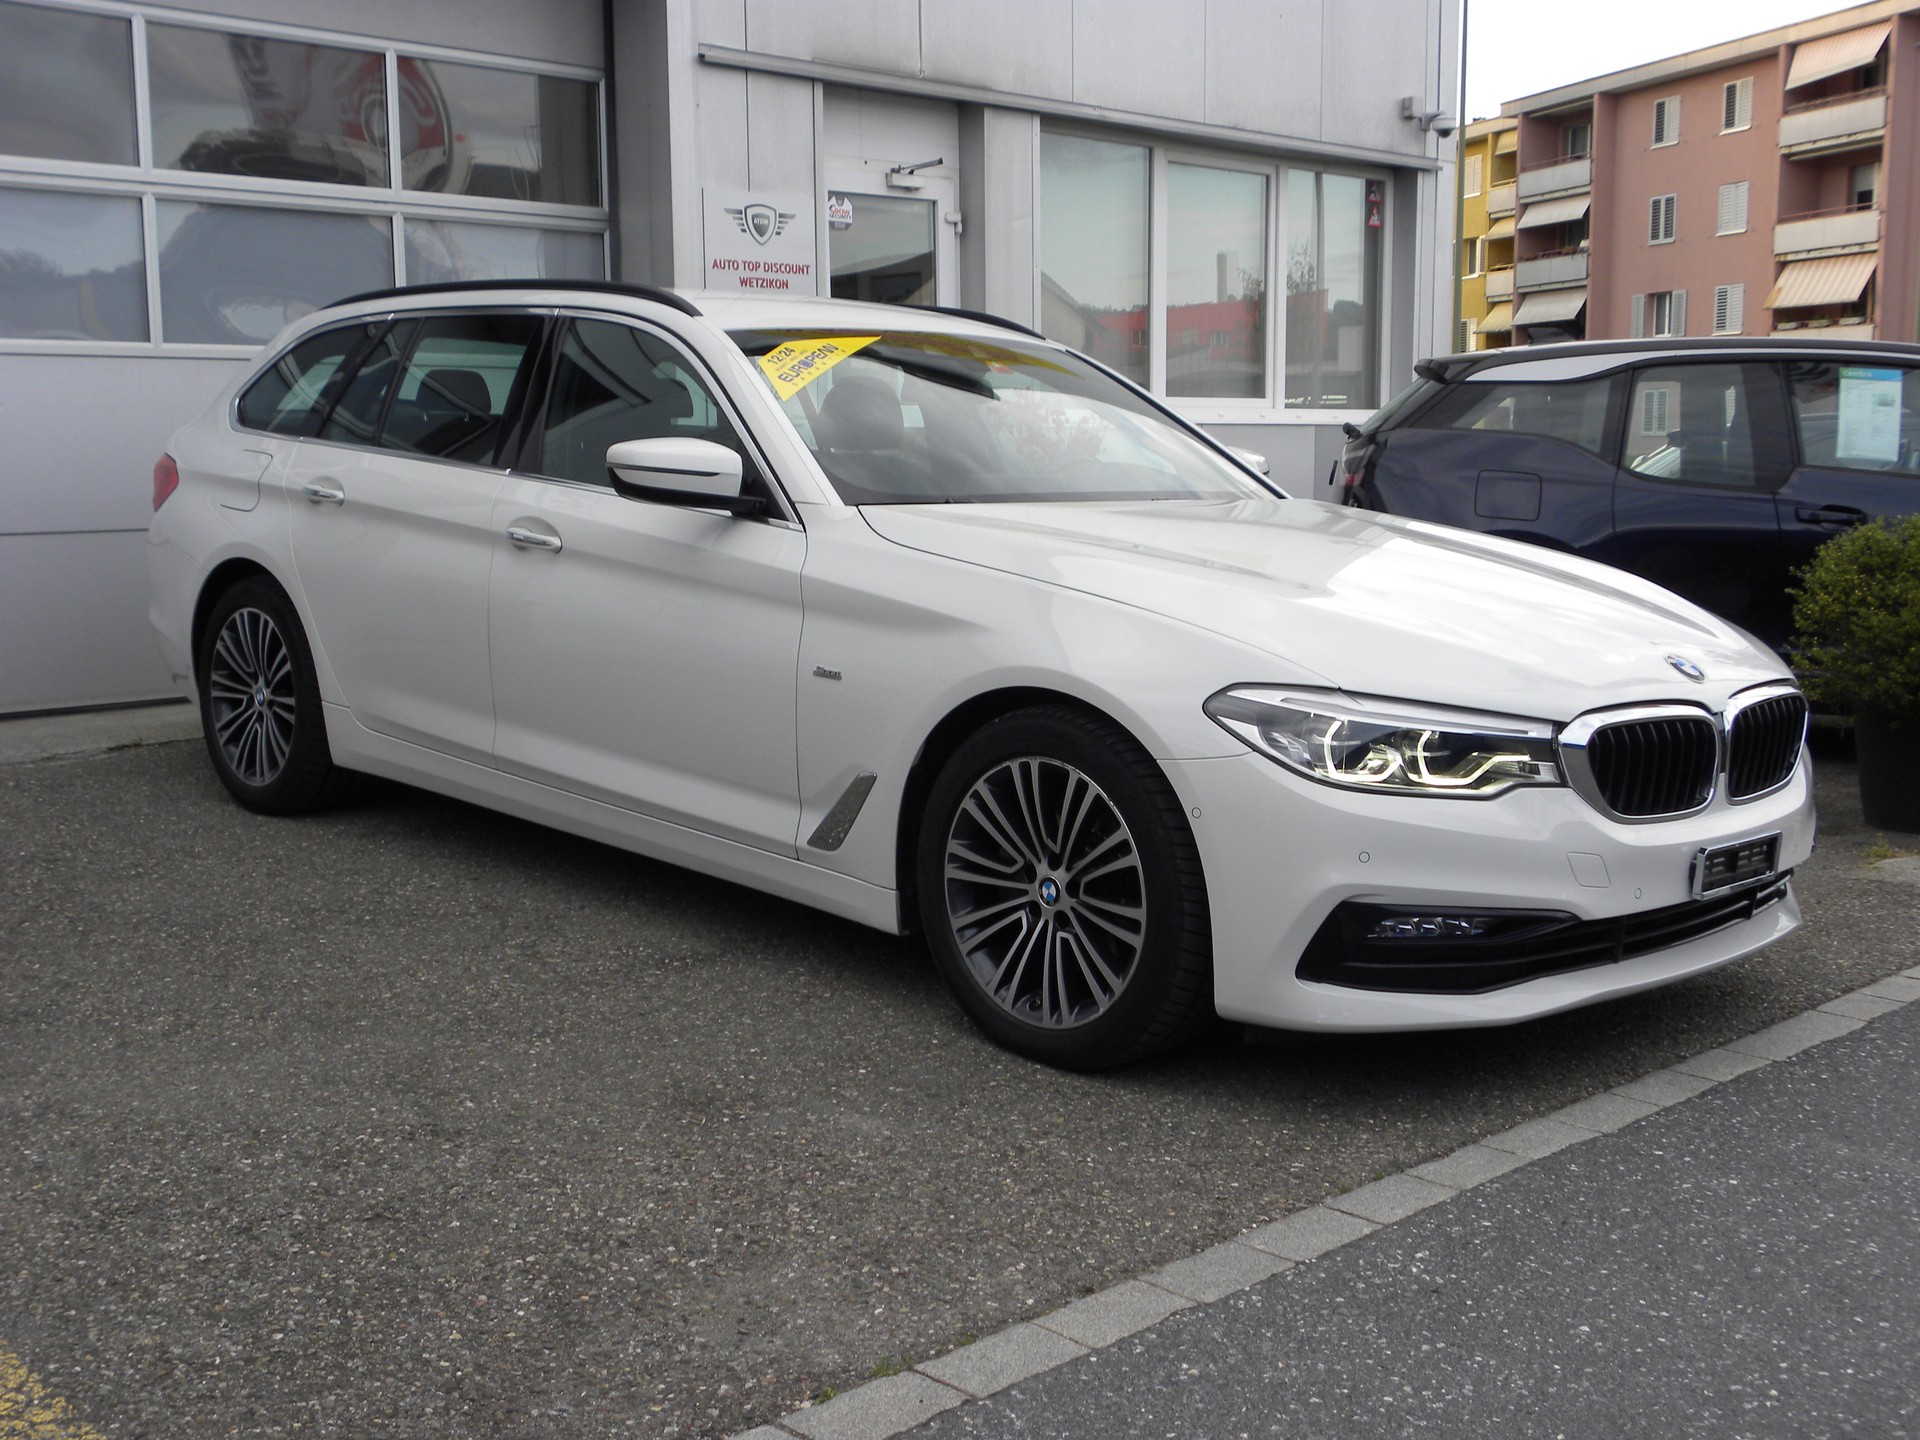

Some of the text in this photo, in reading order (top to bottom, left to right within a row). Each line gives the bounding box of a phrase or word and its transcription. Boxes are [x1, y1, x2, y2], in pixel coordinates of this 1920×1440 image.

[712, 258, 811, 275] AUTO TOP DISCOUNT
[739, 276, 789, 290] WETZIKON
[777, 342, 840, 383] EUROPEAN
